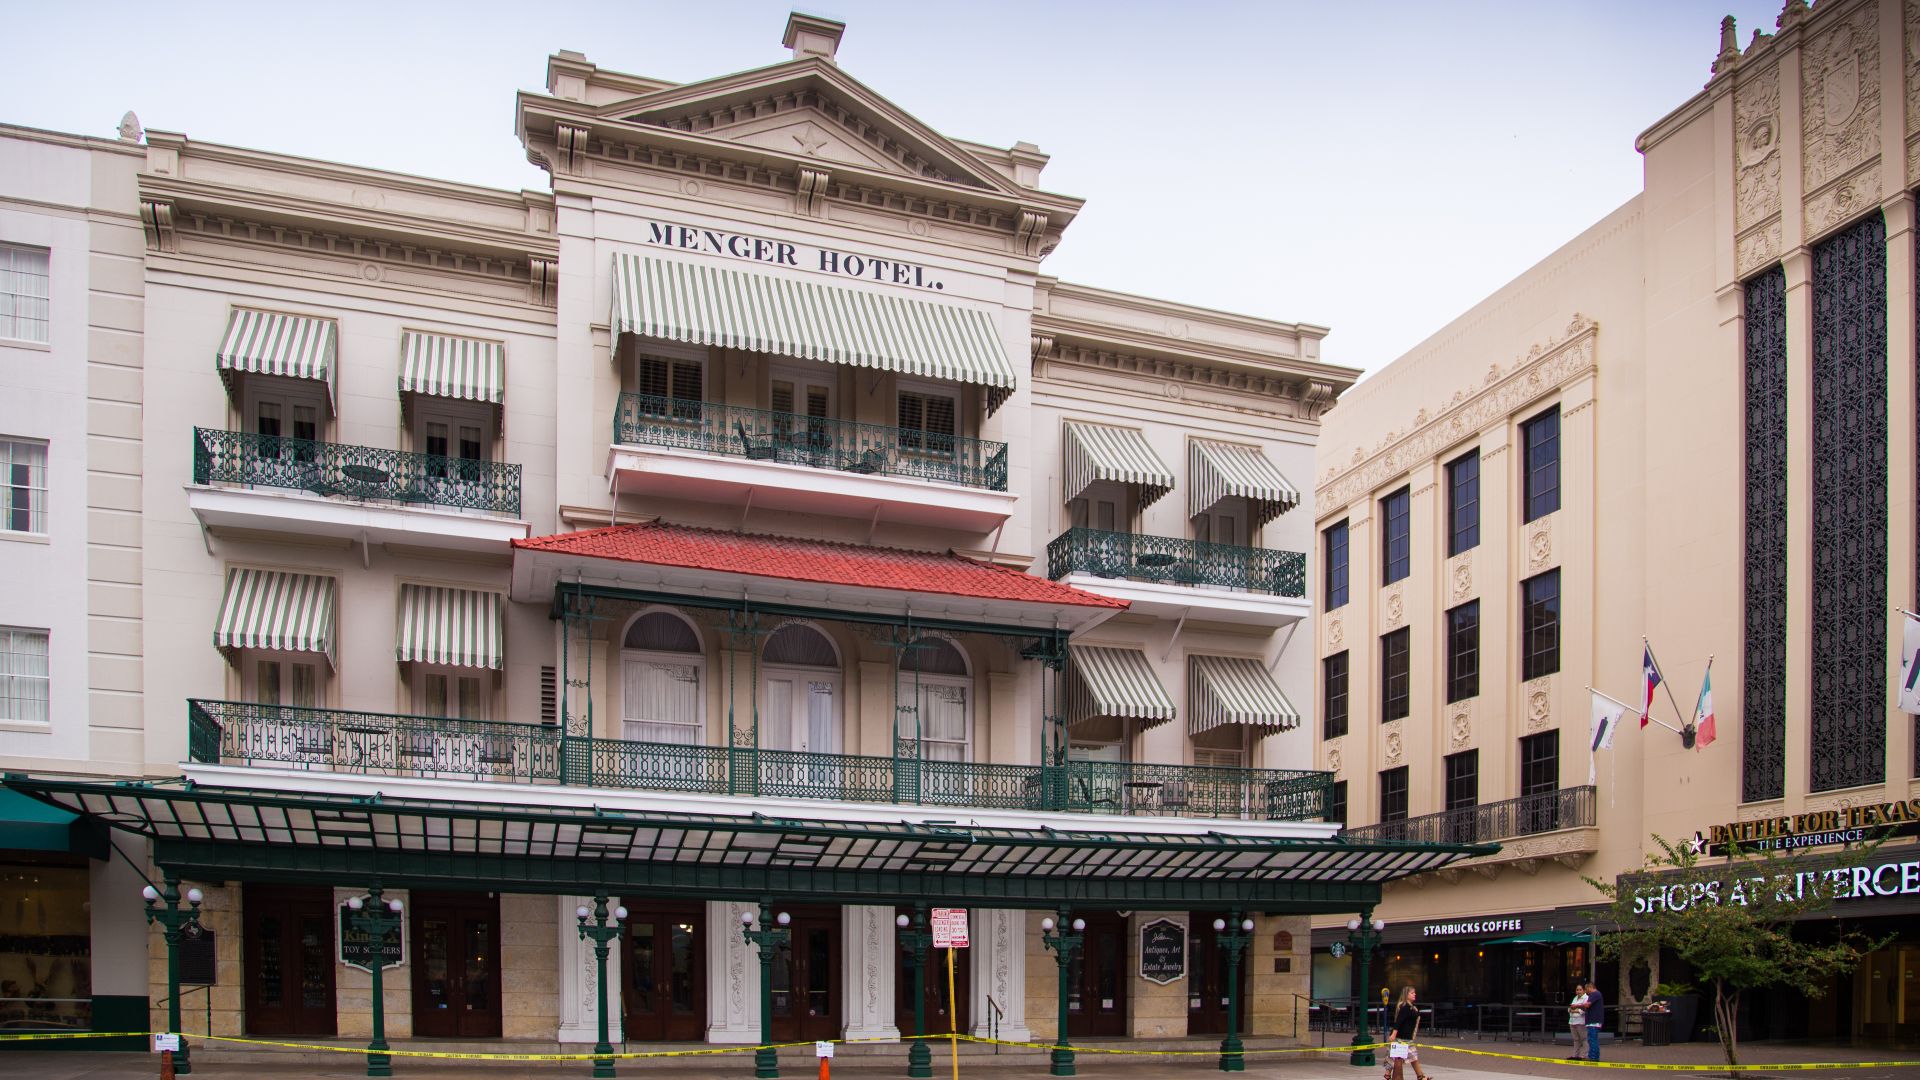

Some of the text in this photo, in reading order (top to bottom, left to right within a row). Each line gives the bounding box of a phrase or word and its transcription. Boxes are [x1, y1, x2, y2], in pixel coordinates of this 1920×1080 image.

[648, 222, 943, 290] MENGER HOTEL.
[1709, 799, 1920, 843] BATTLE FOR TEXAS
[1785, 829, 1863, 848] EXPERIENCE
[1633, 880, 1720, 914] SHOPS
[1423, 919, 1521, 936] STARBUCKS COFFEE
[344, 946, 360, 954] TOY
[1144, 945, 1181, 955] Antiques, Art
[1143, 962, 1182, 971] Estate Jewelry
